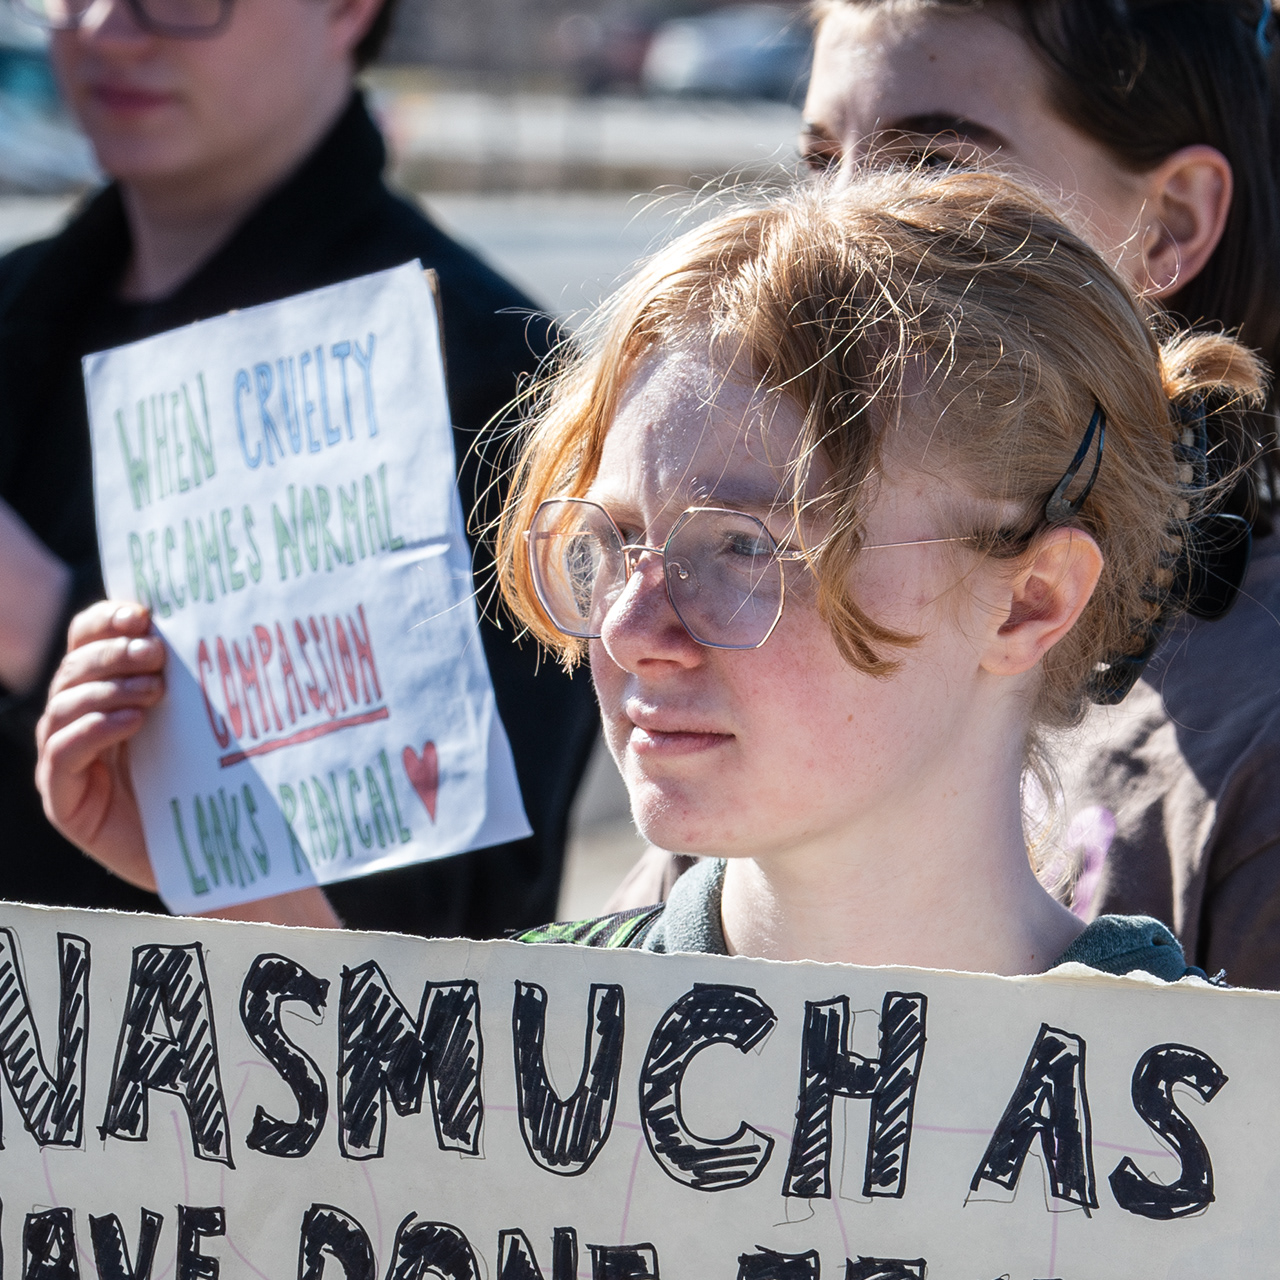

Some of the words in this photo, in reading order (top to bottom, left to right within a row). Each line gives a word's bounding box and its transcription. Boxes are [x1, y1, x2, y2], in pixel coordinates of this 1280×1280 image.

[114, 370, 216, 511] WHEN
[233, 332, 378, 470] CRUELTY
[128, 504, 261, 618] BECOMES
[272, 463, 405, 581] NORMAL
[197, 603, 382, 749] COMPASSION
[170, 783, 268, 895] LOOKS
[279, 748, 412, 876] RADICAL
[969, 1023, 1229, 1220] AS
